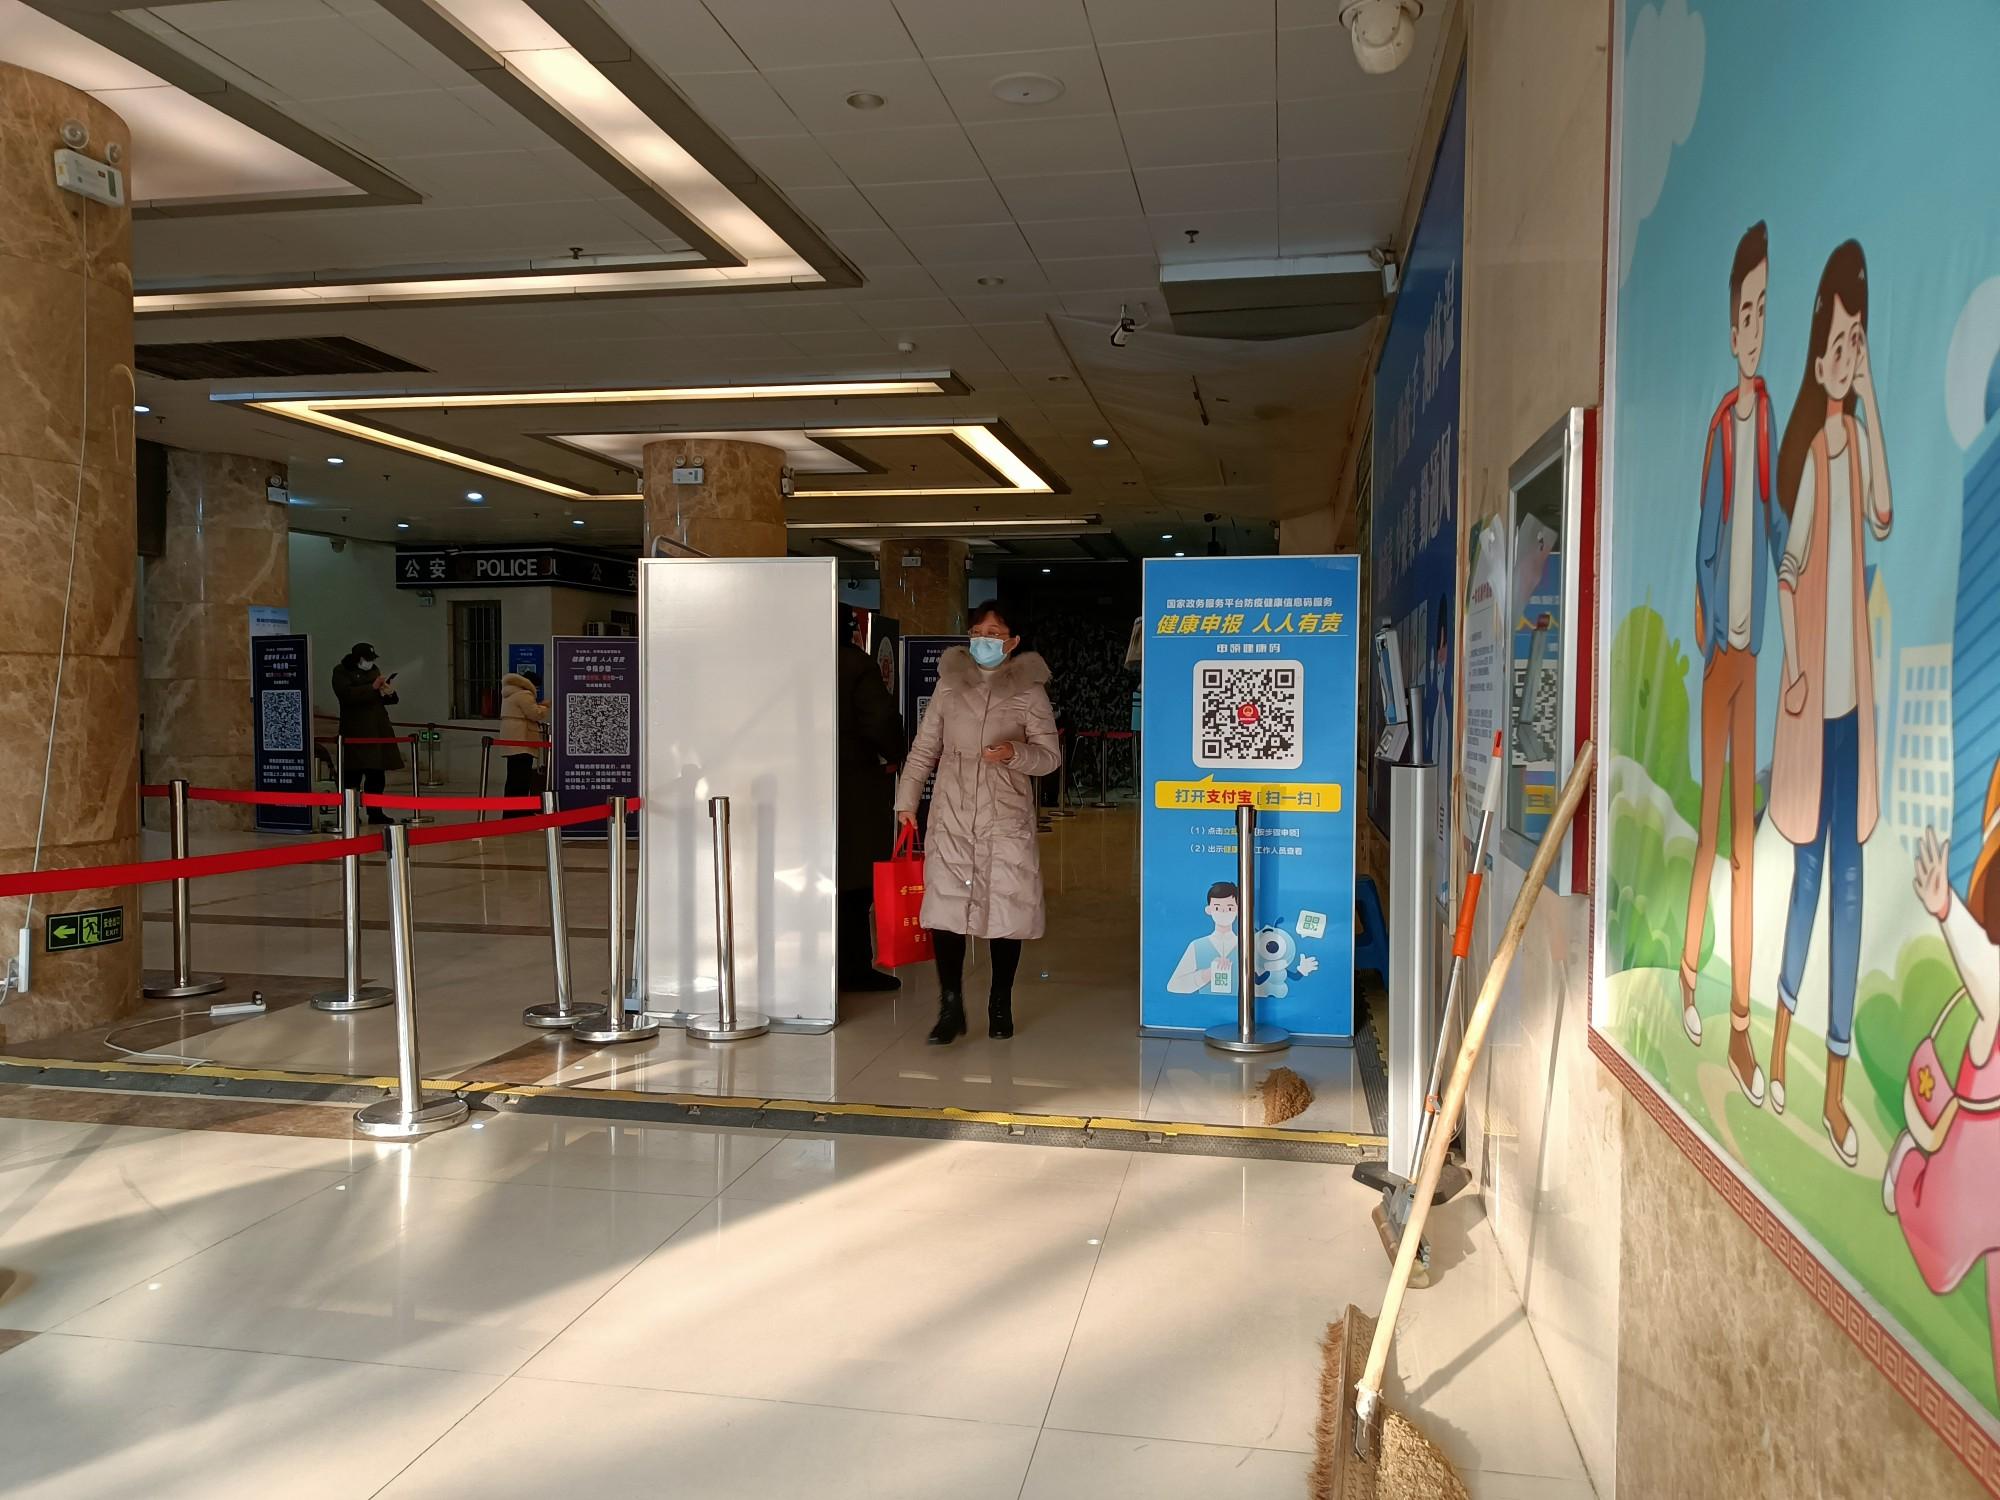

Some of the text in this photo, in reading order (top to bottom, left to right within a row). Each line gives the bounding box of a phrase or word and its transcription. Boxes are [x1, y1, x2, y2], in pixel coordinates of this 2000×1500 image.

[405, 558, 446, 578] 公安
[477, 559, 537, 576] POLICE
[1167, 597, 1333, 609] 国家政务服务平台防疫健康信息码服务
[1156, 613, 1342, 634] 健康申报 人人有责
[1216, 643, 1281, 654] 申领健康码
